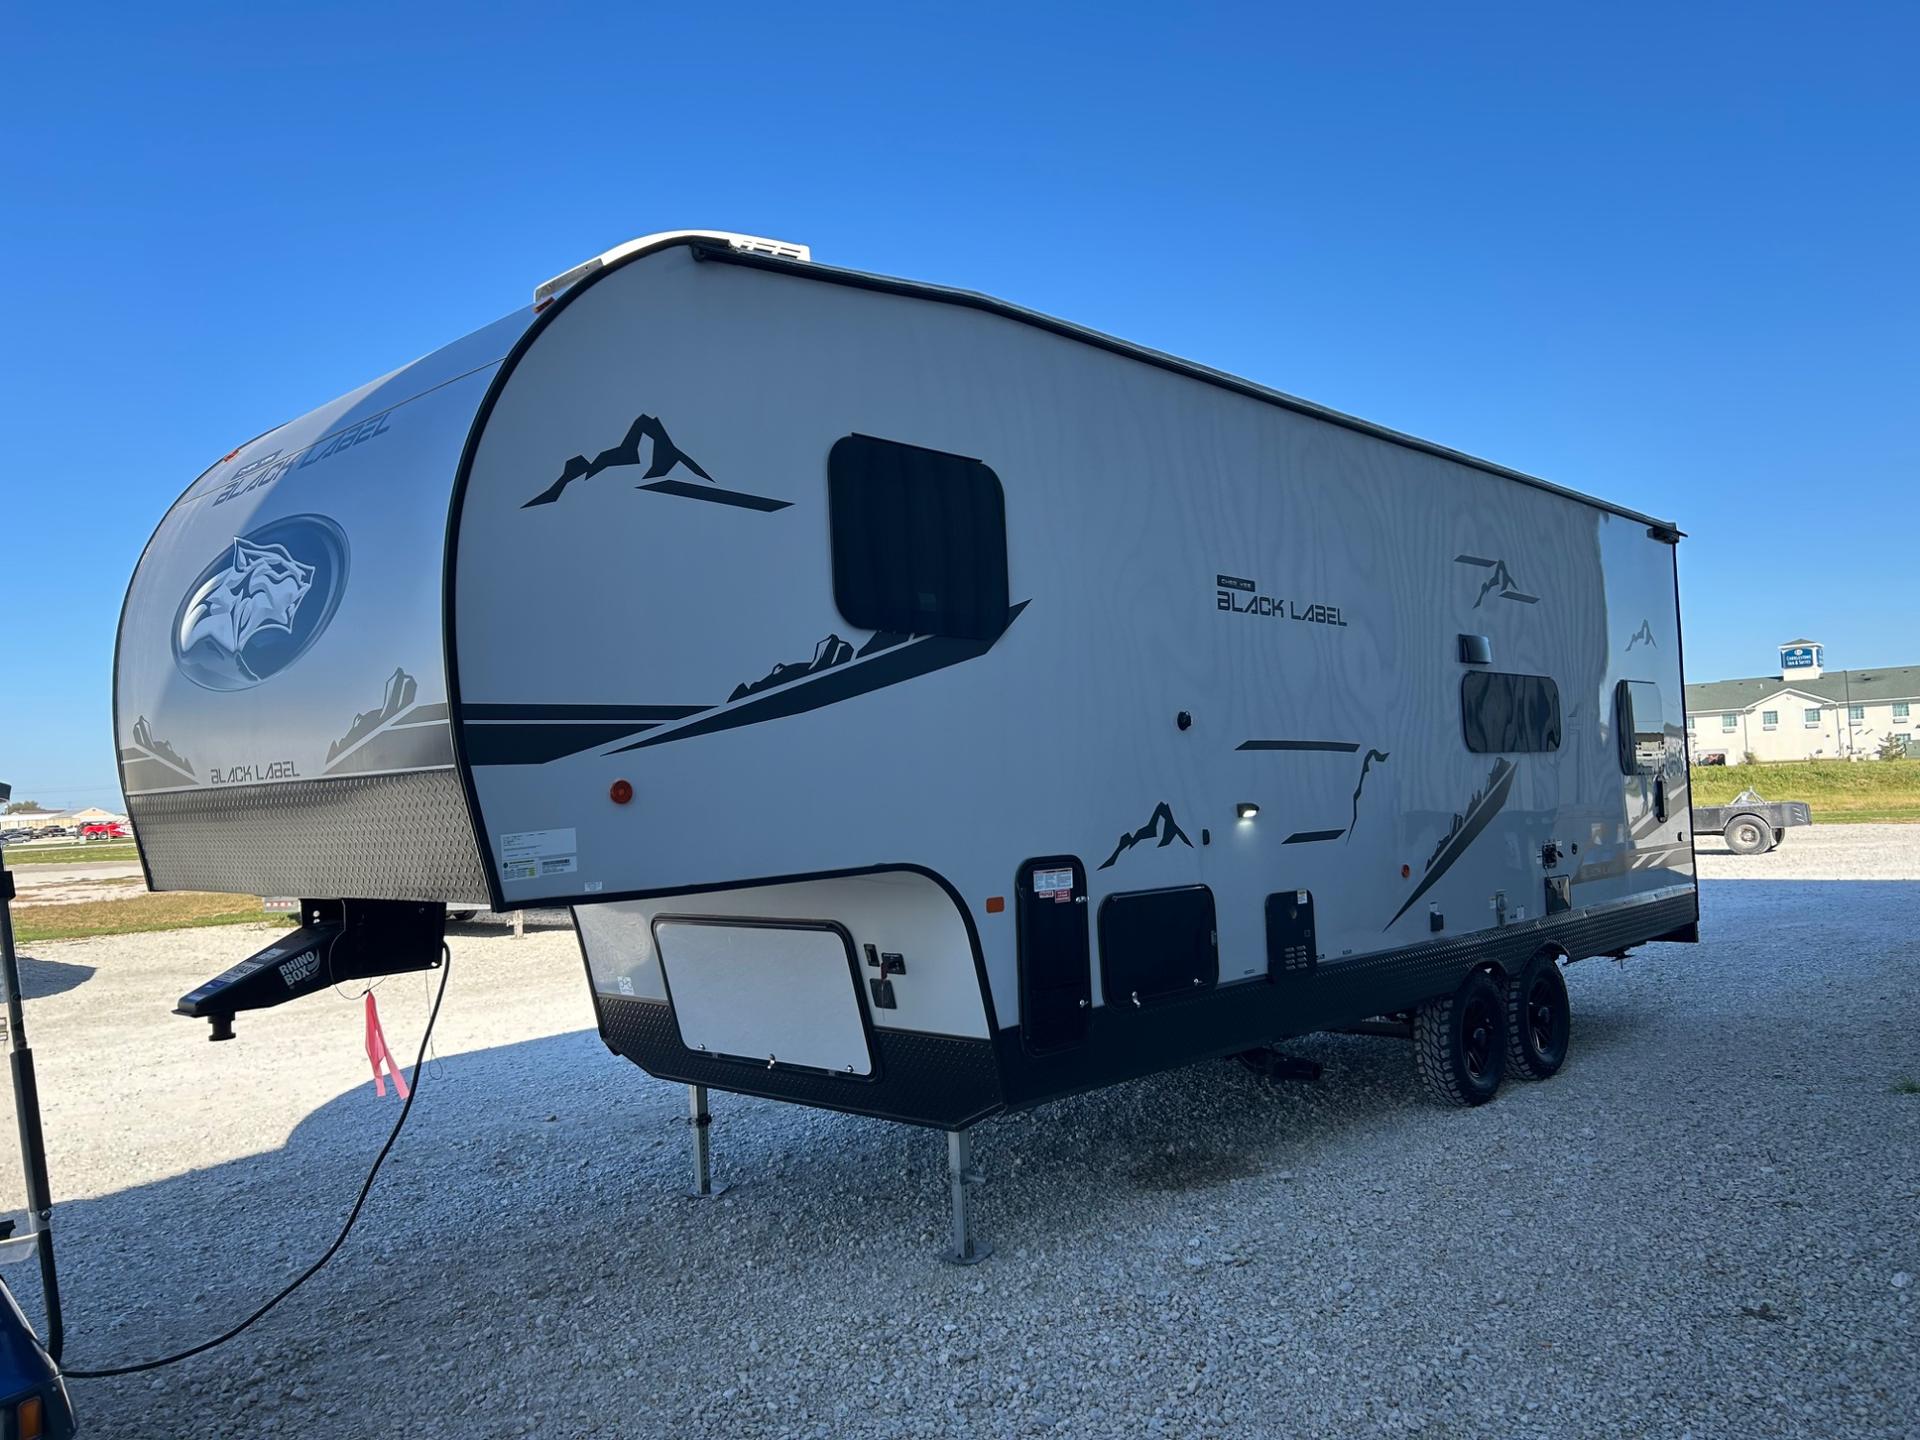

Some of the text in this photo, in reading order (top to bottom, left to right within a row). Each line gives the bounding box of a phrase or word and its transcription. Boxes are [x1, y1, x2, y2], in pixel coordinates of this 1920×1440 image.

[298, 411, 392, 470] LABEL
[1217, 590, 1347, 626] BLACK LABEL
[210, 760, 300, 784] BLACK LABEL
[279, 951, 315, 976] RHINO
[284, 966, 311, 986] BOX
